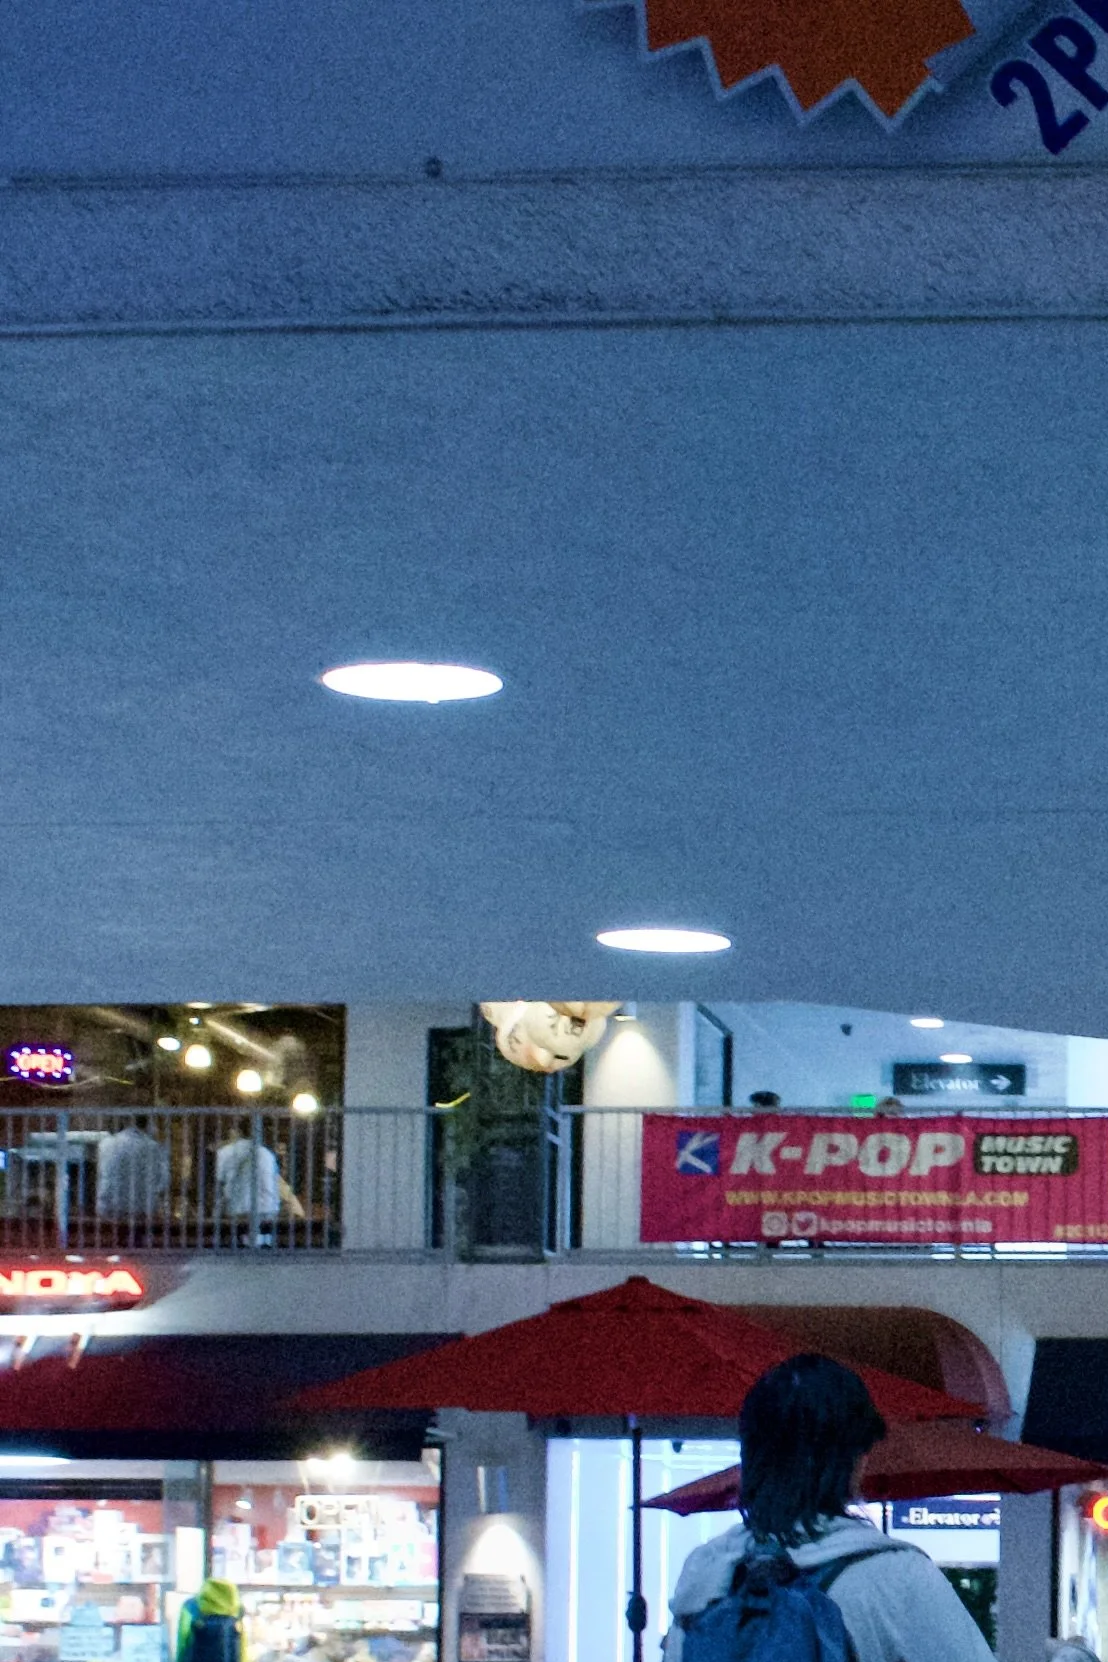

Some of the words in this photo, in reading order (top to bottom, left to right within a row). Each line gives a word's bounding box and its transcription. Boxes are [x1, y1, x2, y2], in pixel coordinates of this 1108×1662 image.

[911, 1073, 980, 1091] Elevator
[980, 1136, 1073, 1153] MUSIC
[729, 1132, 966, 1176] K-POP
[980, 1155, 1064, 1174] TOWN
[909, 1507, 981, 1525] Elevator
